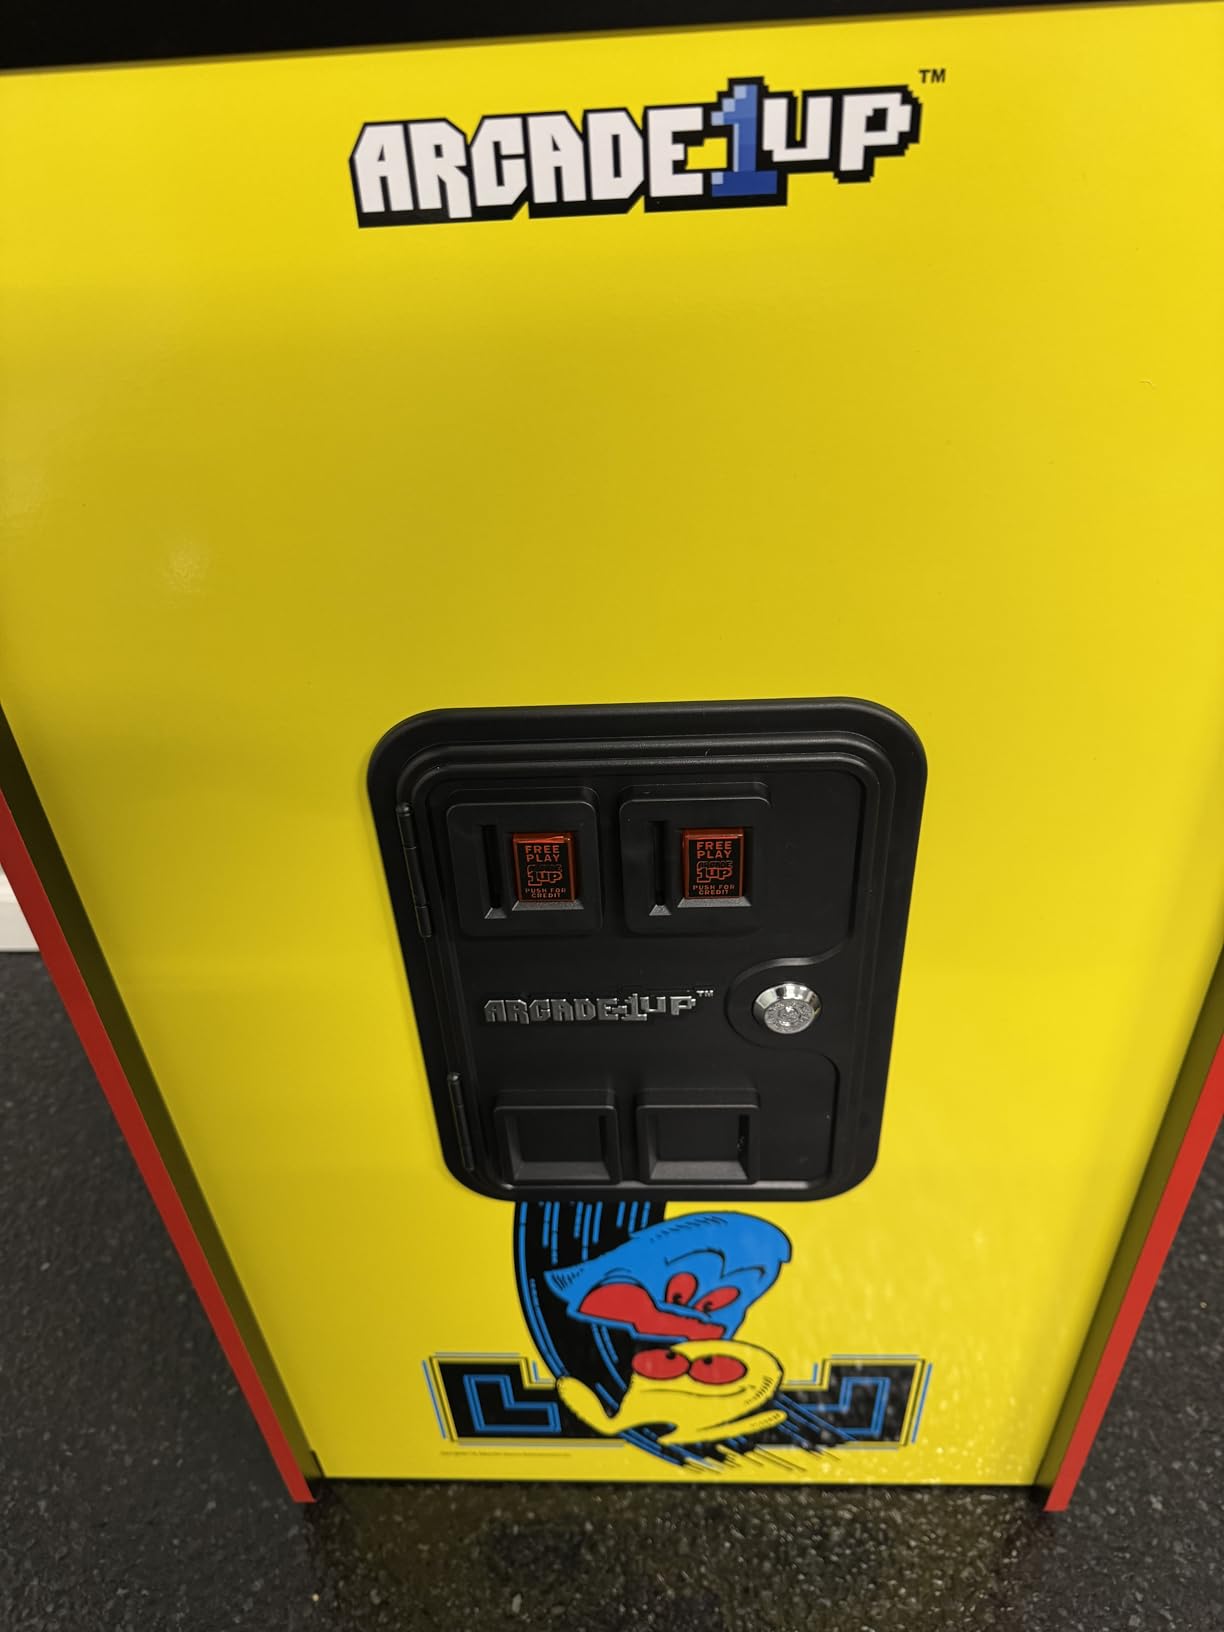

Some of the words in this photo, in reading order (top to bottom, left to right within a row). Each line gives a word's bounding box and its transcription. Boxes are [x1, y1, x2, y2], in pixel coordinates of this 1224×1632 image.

[525, 845, 560, 854] FREE
[696, 841, 733, 850] FREE
[526, 854, 560, 863] PLAY
[697, 850, 732, 859] PLAY
